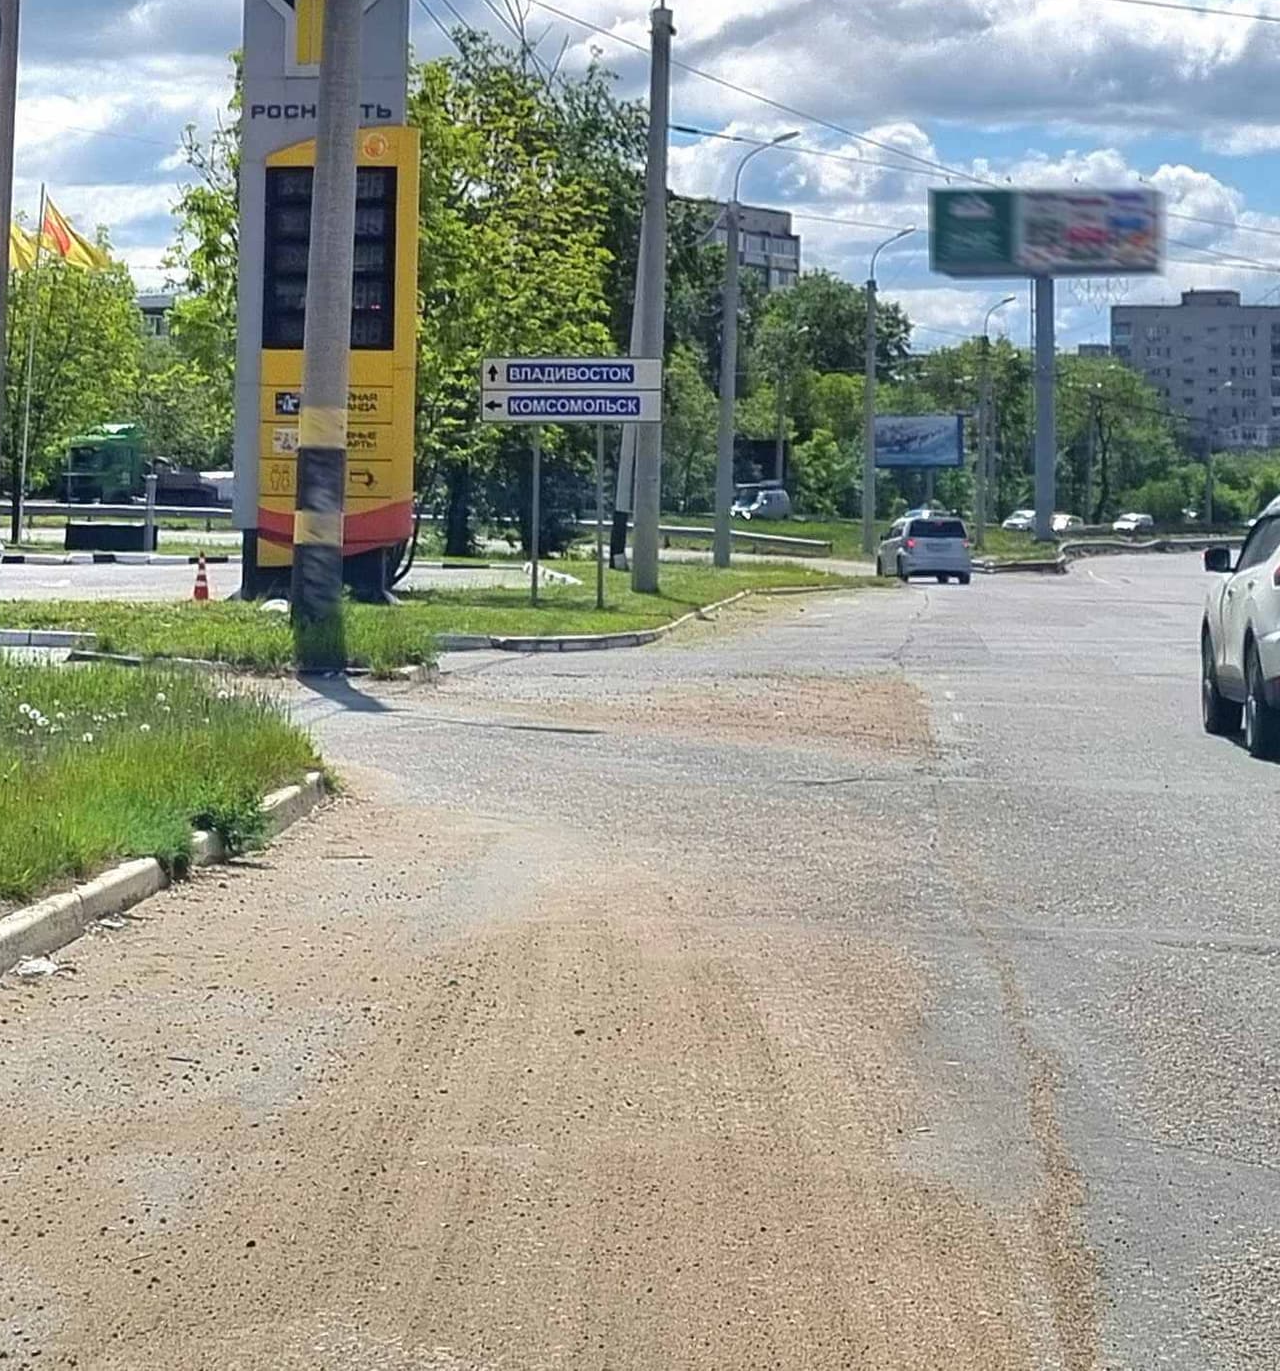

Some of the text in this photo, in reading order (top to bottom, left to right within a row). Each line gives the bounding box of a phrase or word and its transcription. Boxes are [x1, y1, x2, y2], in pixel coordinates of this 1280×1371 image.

[251, 104, 393, 119] РОСНТЬ
[509, 366, 632, 385] ВЛАДИВОСТОК
[510, 398, 638, 414] КОМСОМОЛЬСК
